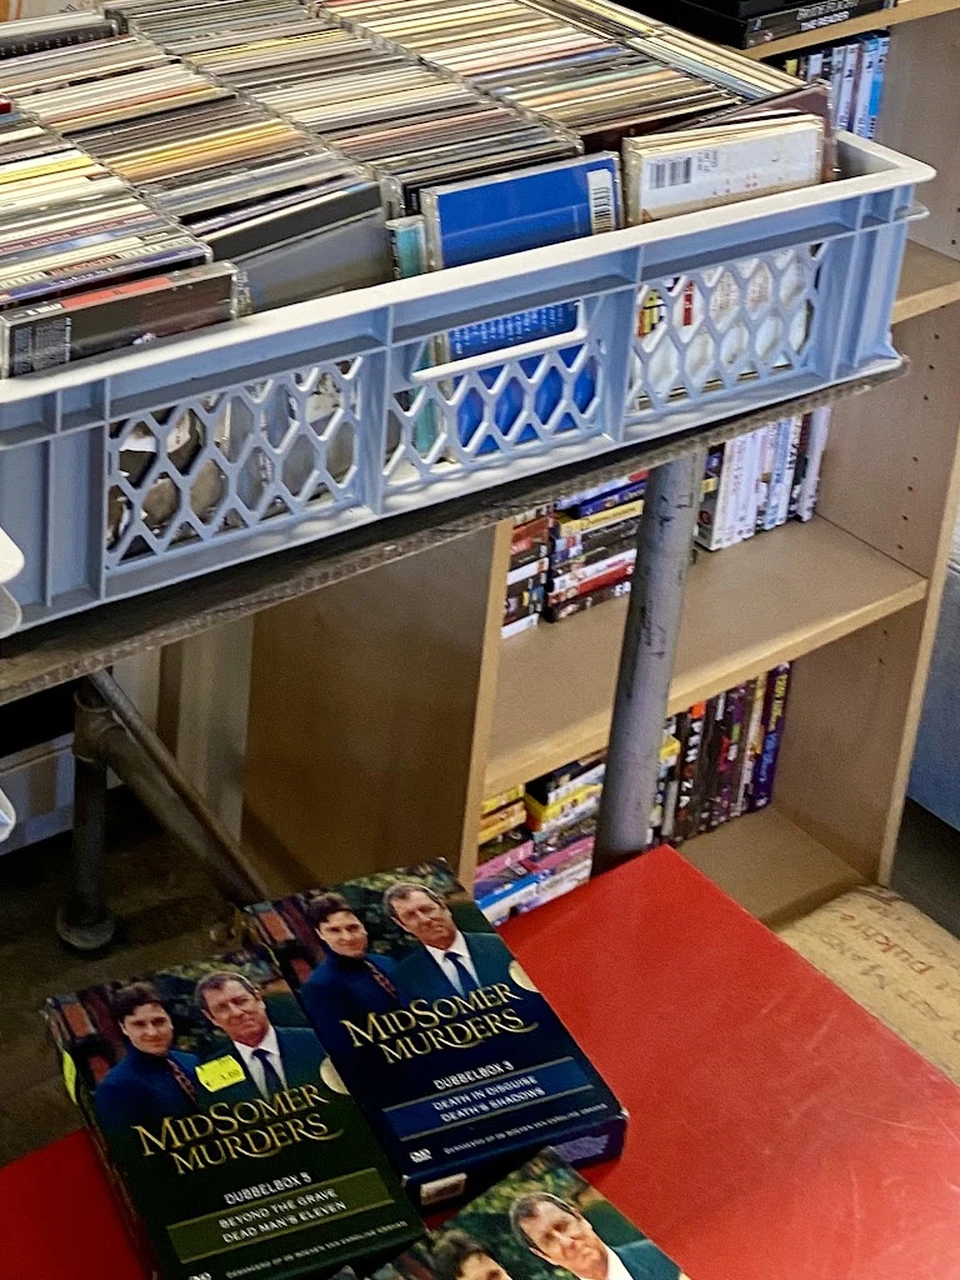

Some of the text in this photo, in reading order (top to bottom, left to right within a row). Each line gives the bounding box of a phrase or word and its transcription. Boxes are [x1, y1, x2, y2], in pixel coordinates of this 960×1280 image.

[816, 11, 850, 28] READER
[339, 982, 524, 1048] MIDSOMER
[377, 1007, 540, 1065] MURDERS
[432, 1075, 540, 1111] DEATH IN DISGUISE
[433, 1064, 504, 1091] DUBBELBOX
[130, 1084, 330, 1157] MIDSOMER
[440, 1086, 546, 1123] DEATH'S SHADOWS
[169, 1112, 345, 1175] MURDERS
[218, 1187, 339, 1230] BEYOND THE GRAVE
[223, 1171, 313, 1205] DUBBELBOX 5
[222, 1200, 348, 1244] DEAD MAN'S ELEVEN
